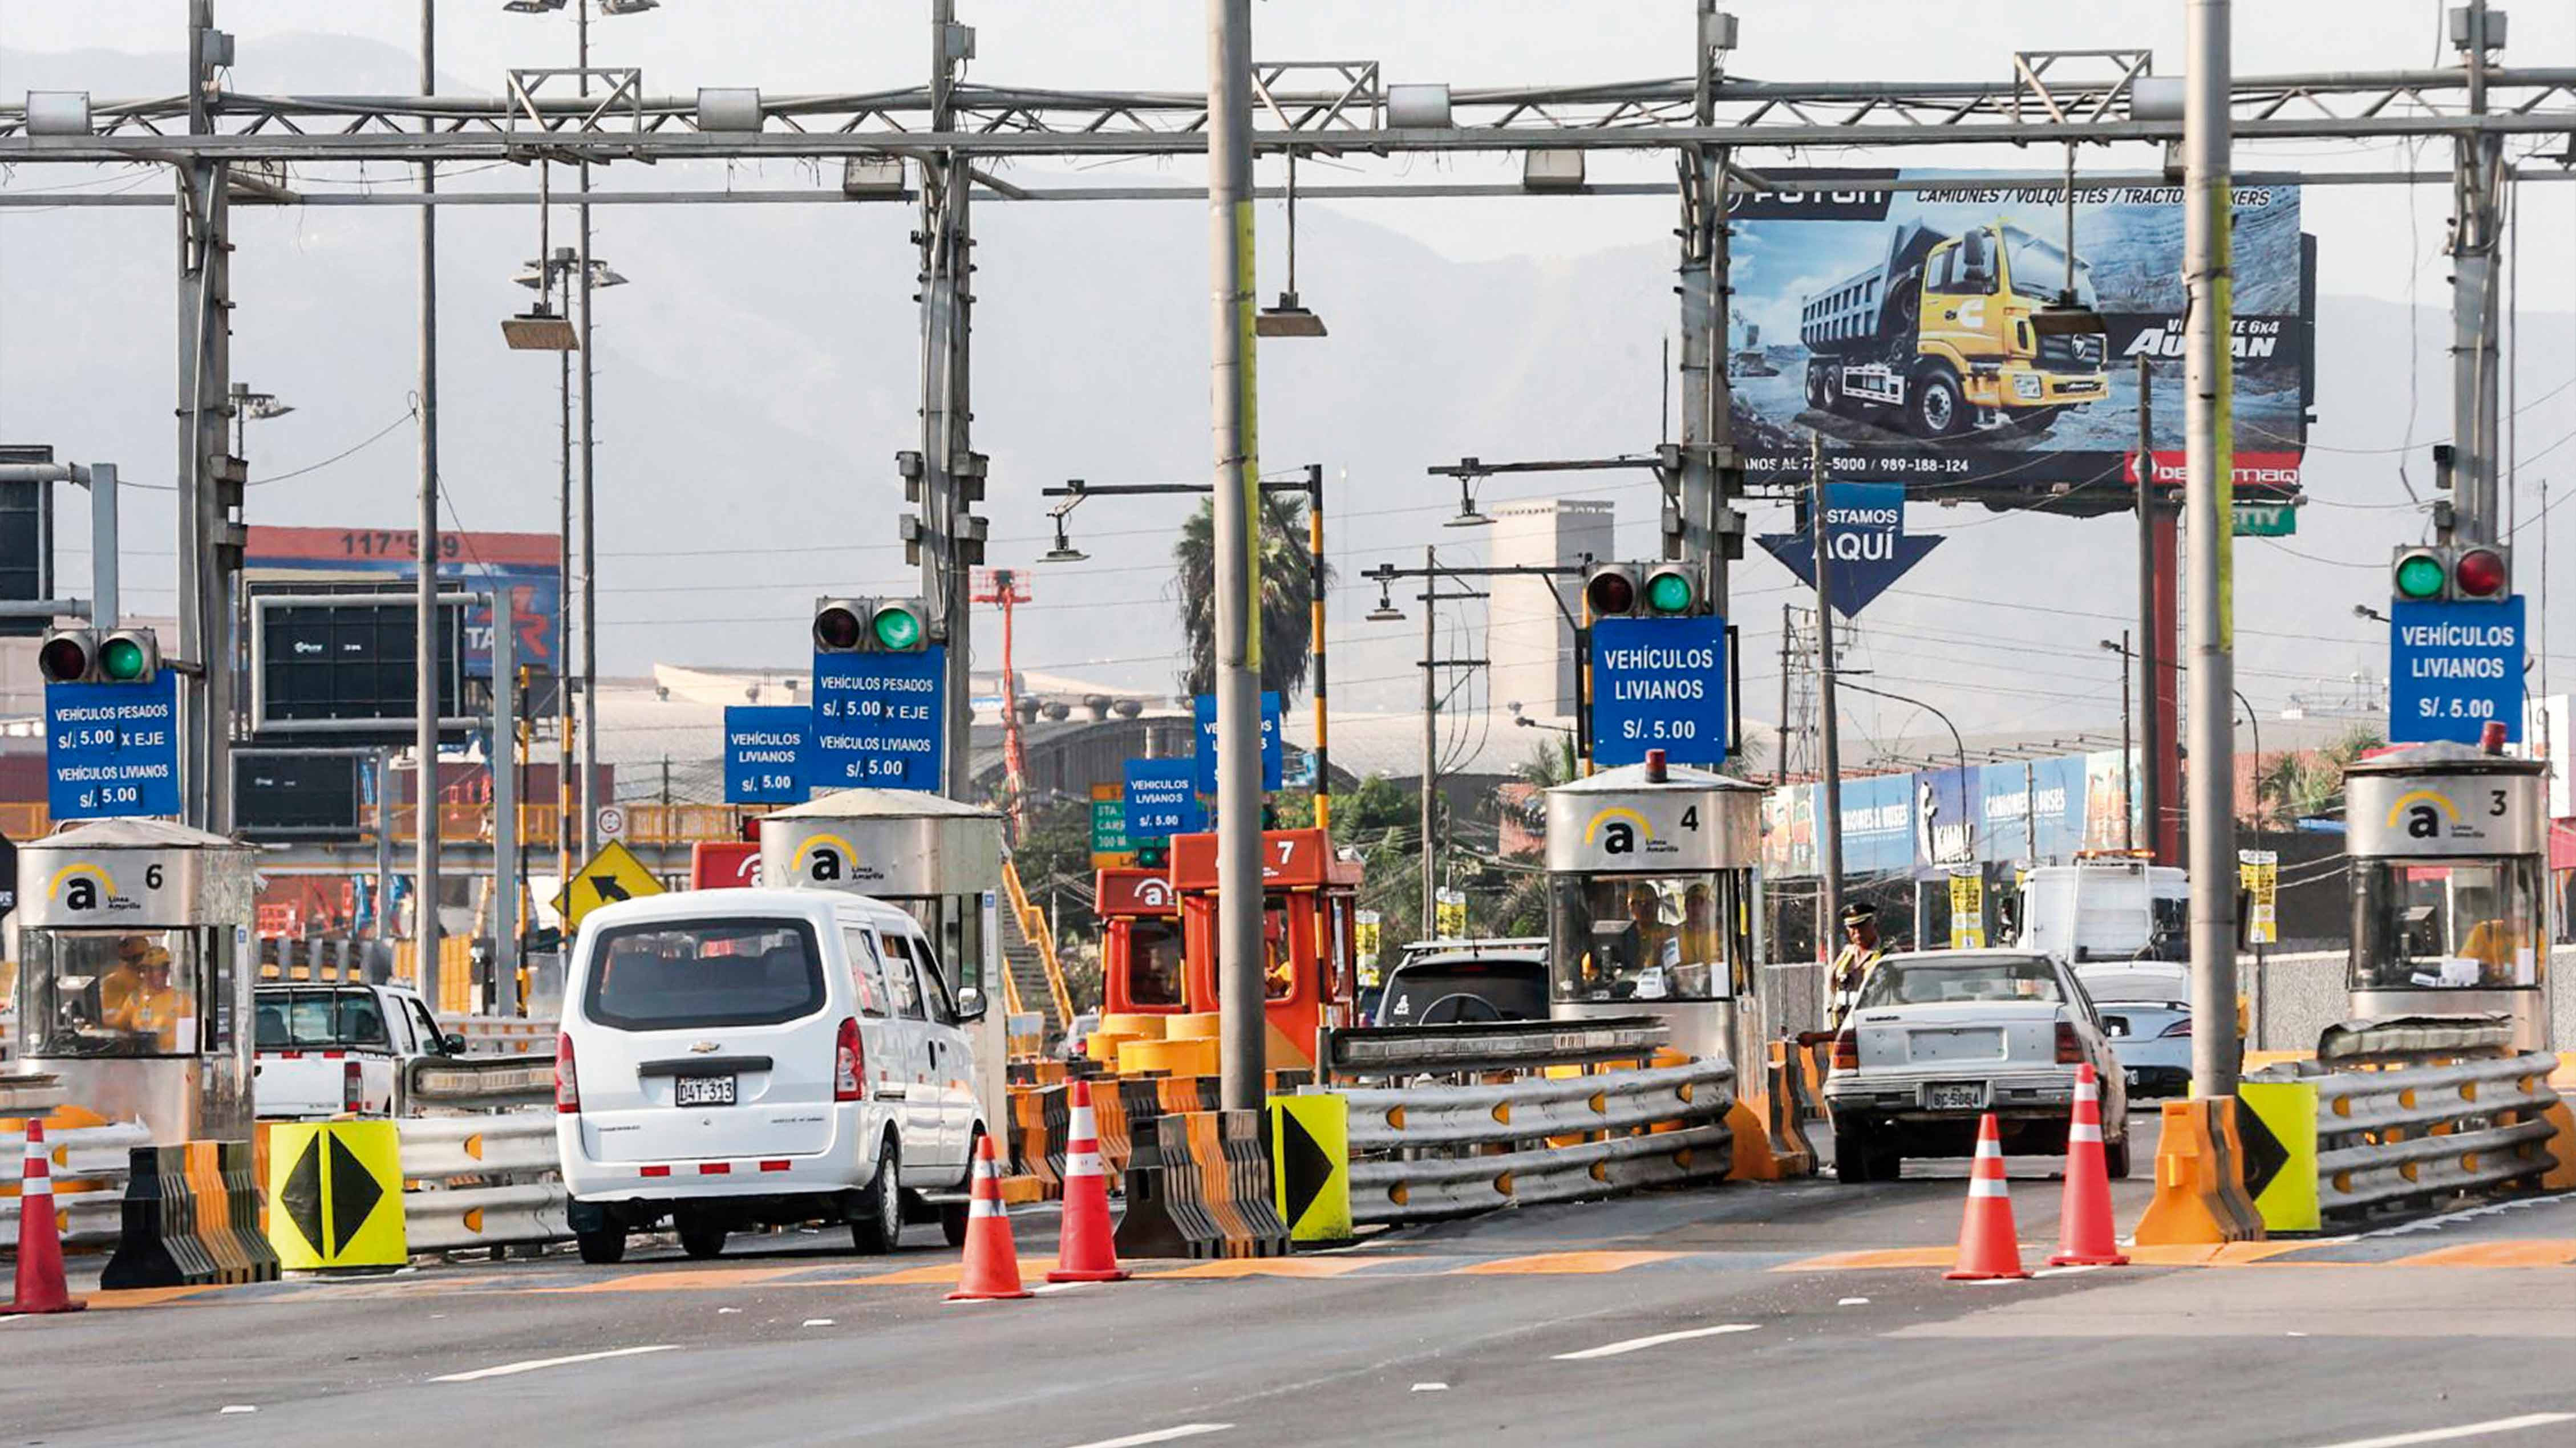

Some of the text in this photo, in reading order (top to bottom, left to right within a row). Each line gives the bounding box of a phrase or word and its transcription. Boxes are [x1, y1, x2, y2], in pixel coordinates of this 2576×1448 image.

[1917, 188, 2001, 202] CAMIONES
[2249, 321, 2280, 334] 6x4
[2123, 328, 2277, 356] AUAN
[1881, 458, 1969, 472] 989-188-124
[1826, 509, 1898, 524] STAMOS
[2401, 622, 2514, 647] VEHÍCULOS
[1605, 644, 1713, 670] VEHÍCULOS
[2412, 658, 2505, 678] LIVIANOS
[820, 674, 933, 692] VEHÍCULOS PESADOS
[1615, 680, 1703, 700] LIVIANOS
[55, 704, 168, 721] VEHÍCULOS PESADOS
[846, 701, 881, 716] 5.00
[900, 706, 929, 720] EJE
[2419, 696, 2494, 717] S/. 5.00
[80, 729, 114, 744] 5.00
[134, 732, 164, 745] EJE
[731, 731, 801, 745] VEHÍCULOS
[1623, 719, 1695, 739] S/. 5.00
[820, 733, 931, 752] VEHÍCULOS LIVIANOS
[739, 751, 795, 762] LIVIANOS
[57, 764, 168, 781] VEHÍCULOS LIVIANOS
[868, 760, 902, 775] 5.00
[762, 776, 791, 788] 5.00
[102, 788, 137, 803] 5.00
[1136, 793, 1184, 804] LIVIANOS
[2489, 790, 2507, 816] 3
[1155, 814, 1179, 826] 5.00
[1680, 805, 1699, 832] 4
[2408, 805, 2439, 838] a
[1605, 822, 1634, 854] a
[1278, 841, 1294, 865] 7
[812, 849, 840, 882] a
[145, 864, 163, 890] 6
[67, 878, 96, 911] a
[1144, 887, 1162, 906] a
[679, 1082, 734, 1101] D4T-313
